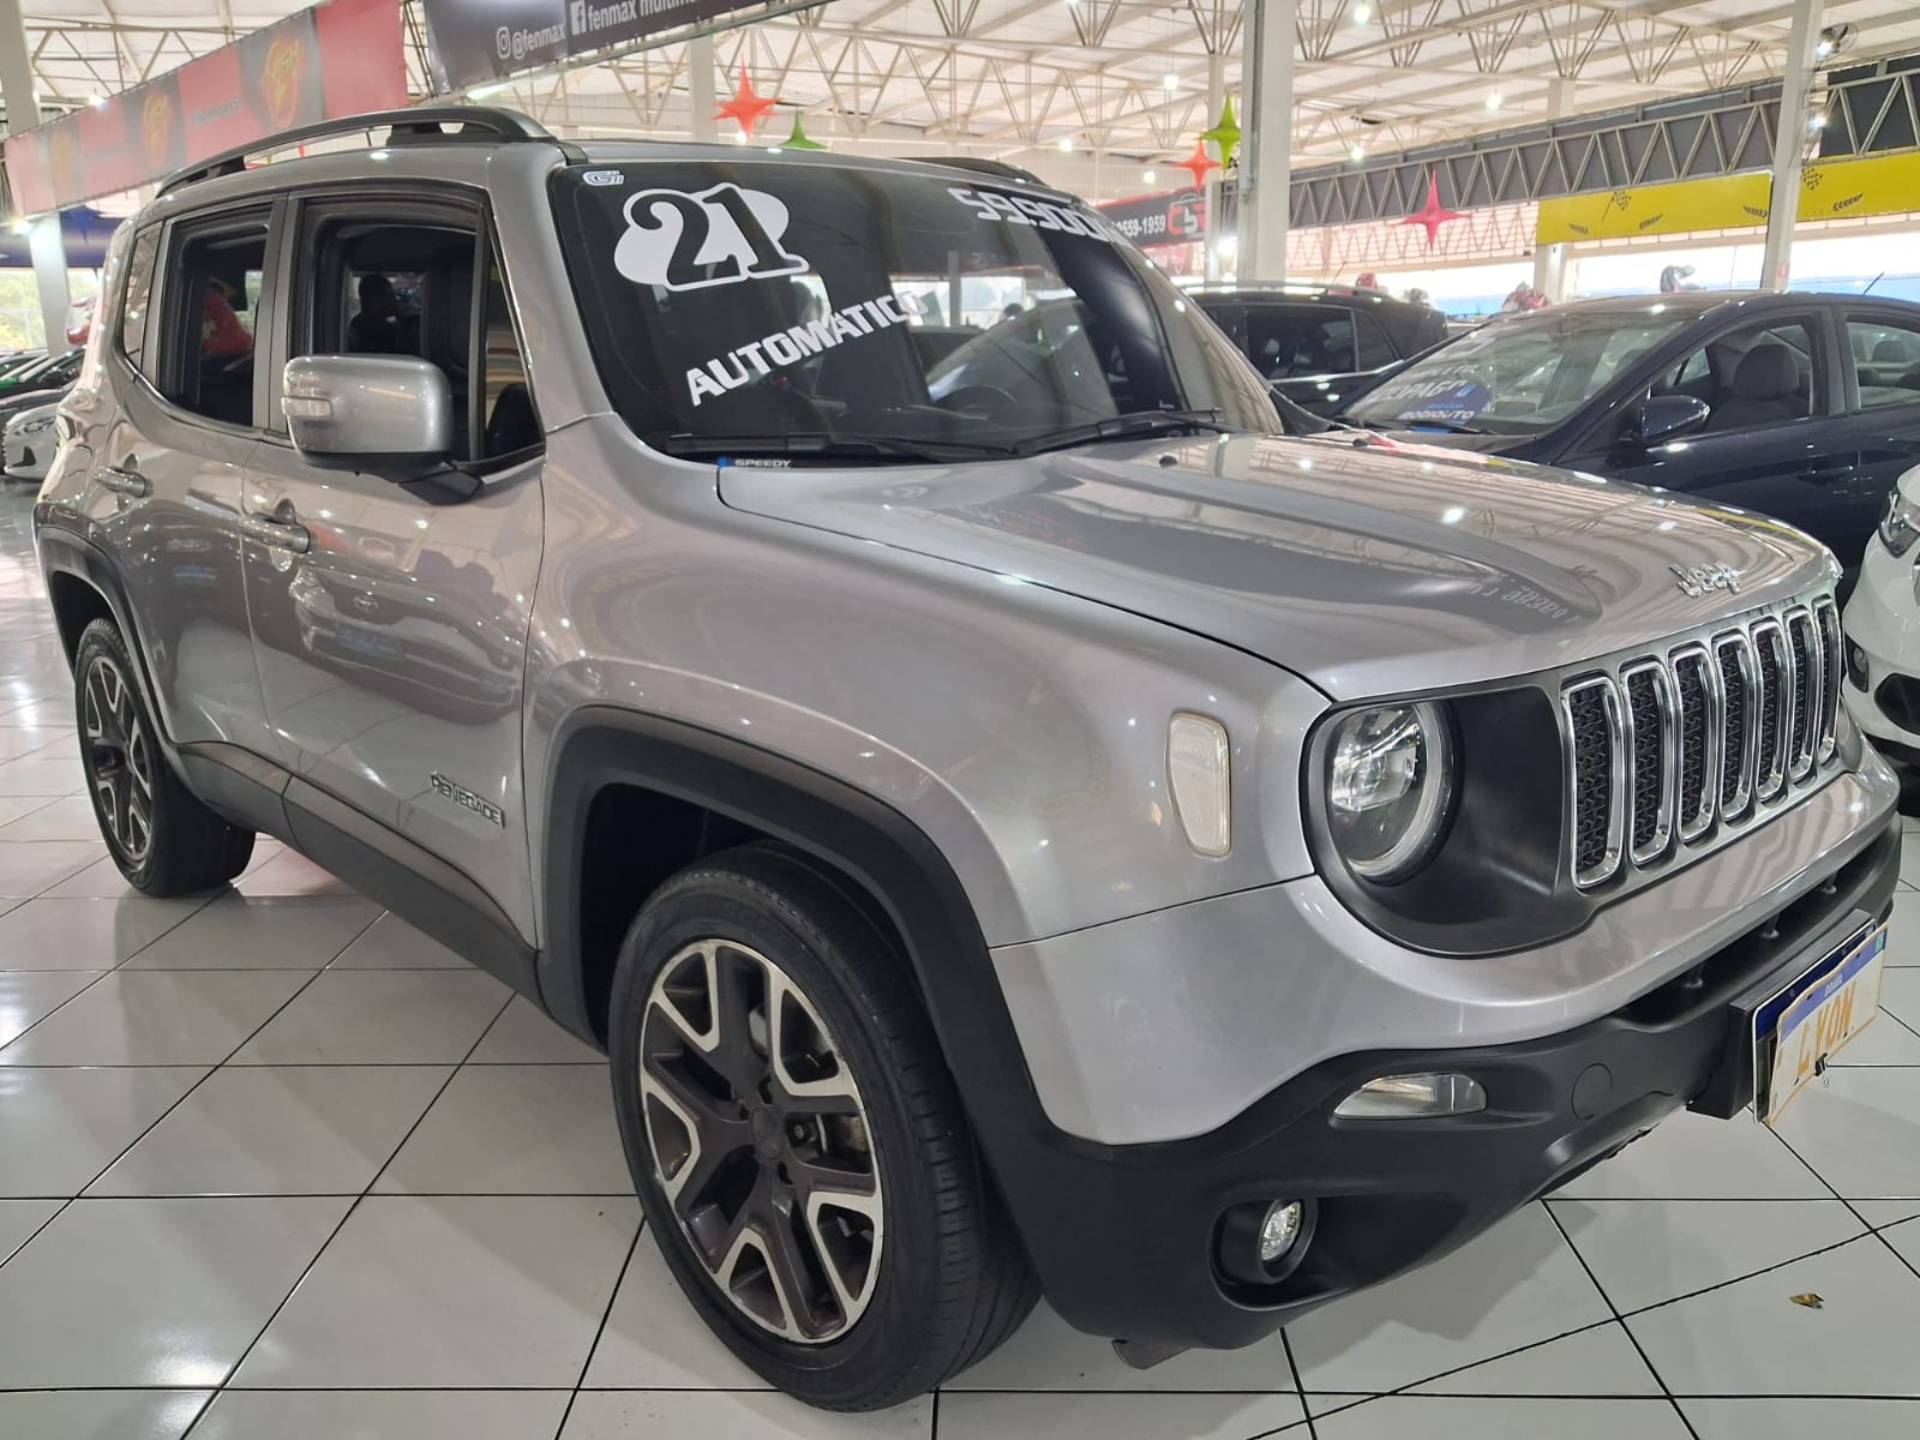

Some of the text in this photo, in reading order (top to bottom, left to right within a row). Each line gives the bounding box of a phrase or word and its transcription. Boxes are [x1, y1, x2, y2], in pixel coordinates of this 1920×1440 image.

[587, 1, 637, 31] fenmax
[511, 23, 566, 60] @fenmax
[626, 184, 807, 288] 21
[686, 290, 930, 407] AUTOMATICO
[735, 459, 792, 469] SPEEDY
[430, 770, 506, 829] RENEGADE
